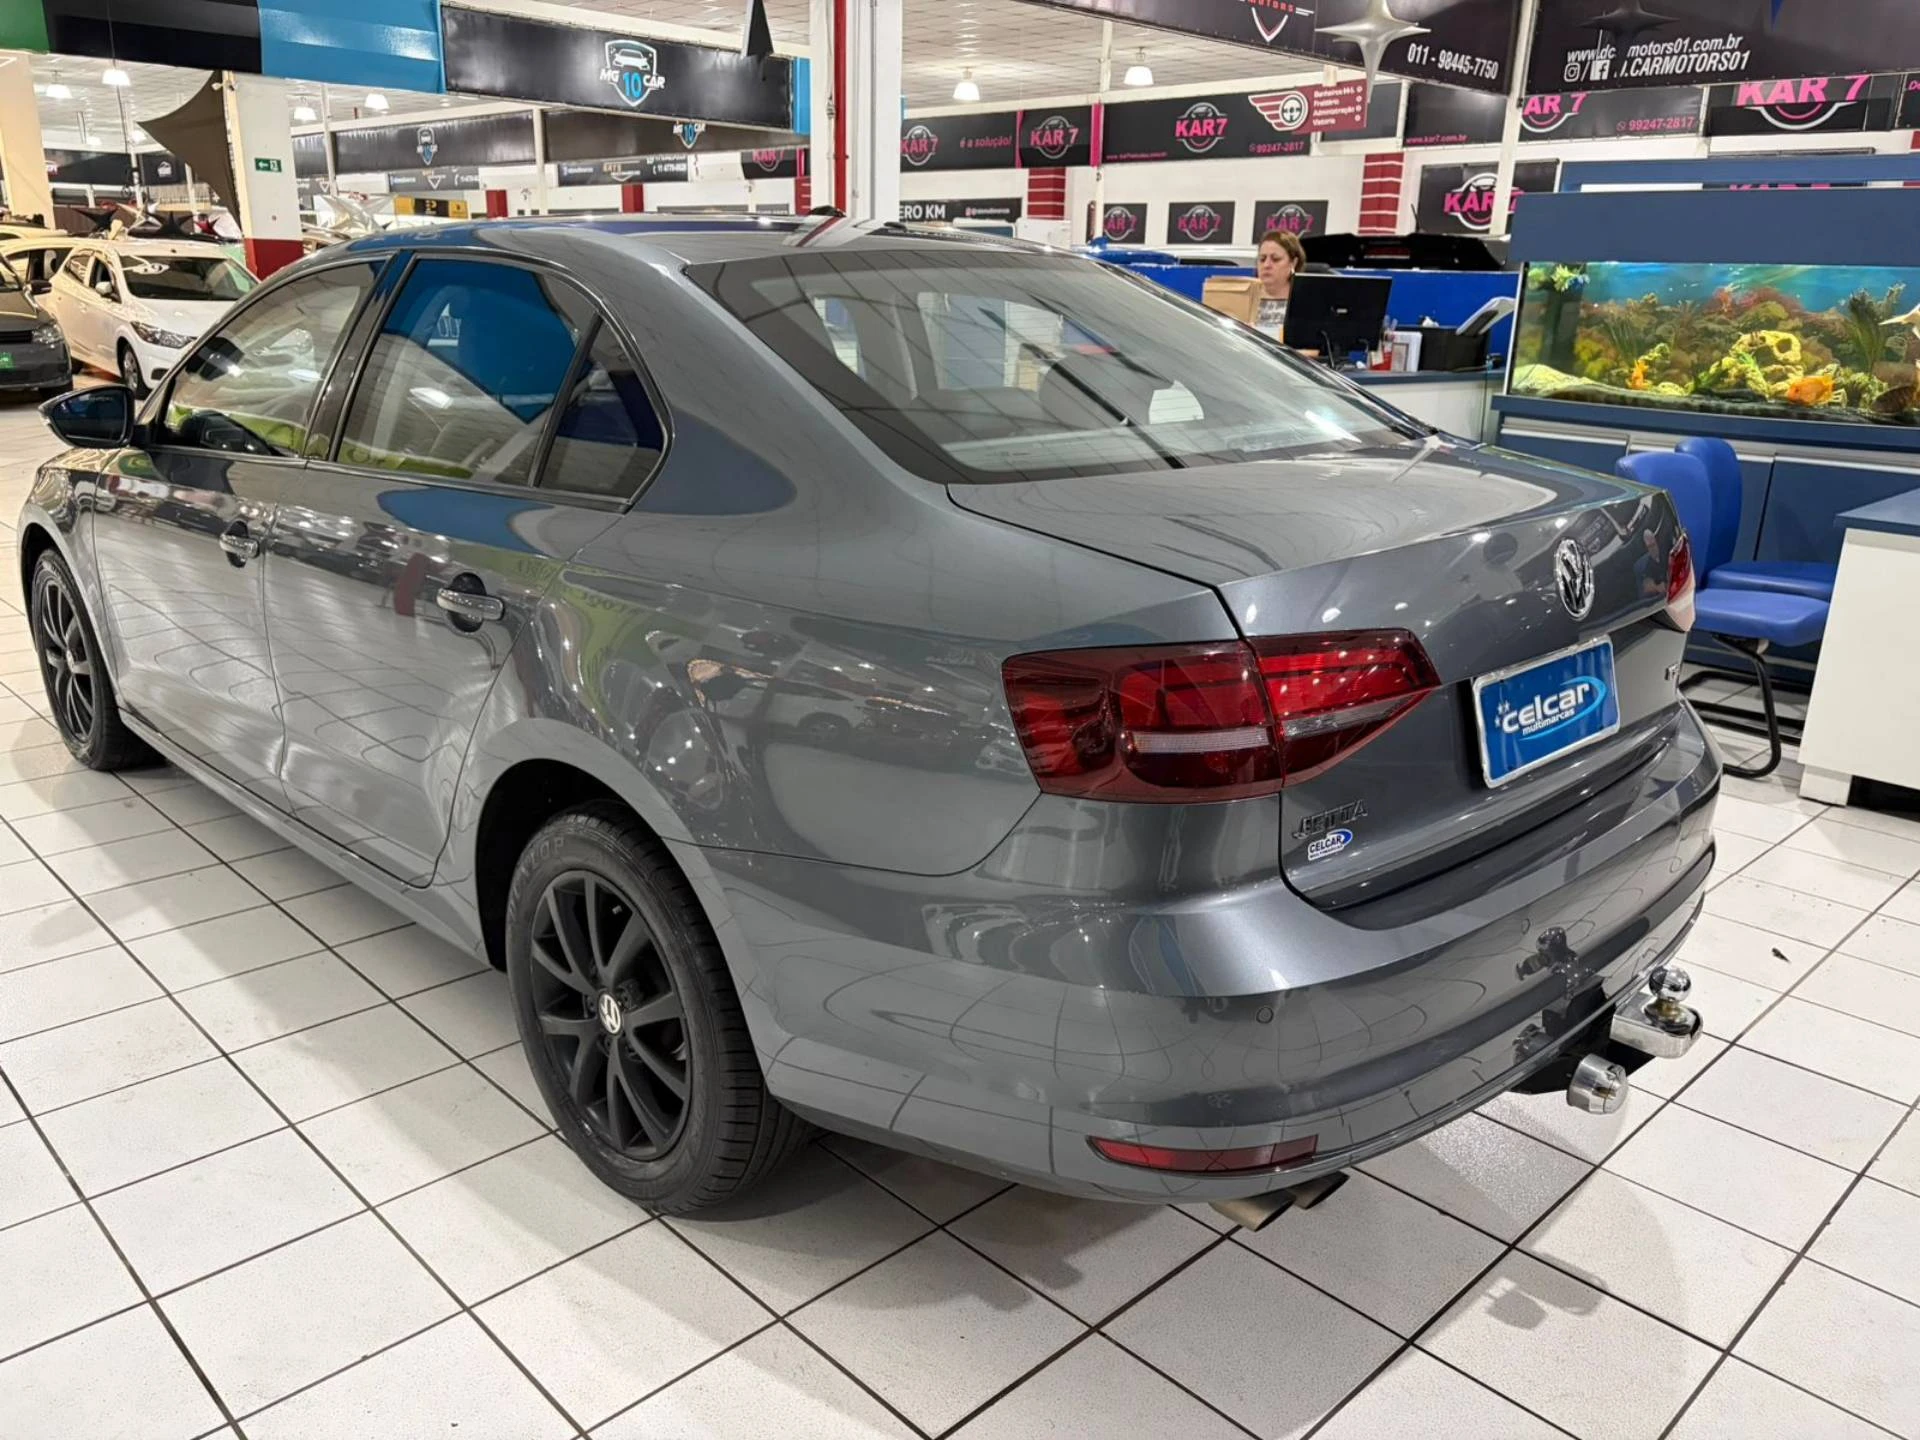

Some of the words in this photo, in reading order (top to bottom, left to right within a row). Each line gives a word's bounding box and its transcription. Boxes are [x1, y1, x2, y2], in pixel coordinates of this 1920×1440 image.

[1407, 43, 1430, 66] 011
[1437, 49, 1499, 80] 98445-7750
[600, 68, 620, 83] MG
[623, 71, 642, 98] 10
[643, 74, 666, 89] CAR
[1737, 77, 1829, 106] KAR
[1845, 74, 1871, 101] 7
[1523, 95, 1561, 115] AR
[1571, 92, 1587, 113] 7
[1629, 117, 1695, 131] 99247-2817
[930, 136, 939, 153] 7
[1030, 128, 1064, 146] KAR
[1069, 128, 1079, 145] 7
[925, 204, 946, 220] KM
[1106, 216, 1126, 231] AR
[1178, 216, 1209, 231] KAR
[1265, 216, 1300, 231] KAR
[1502, 683, 1590, 734] celcar
[1522, 709, 1576, 736] multimarcas
[1291, 799, 1369, 839] JETTA
[1309, 834, 1344, 854] CELCAR
